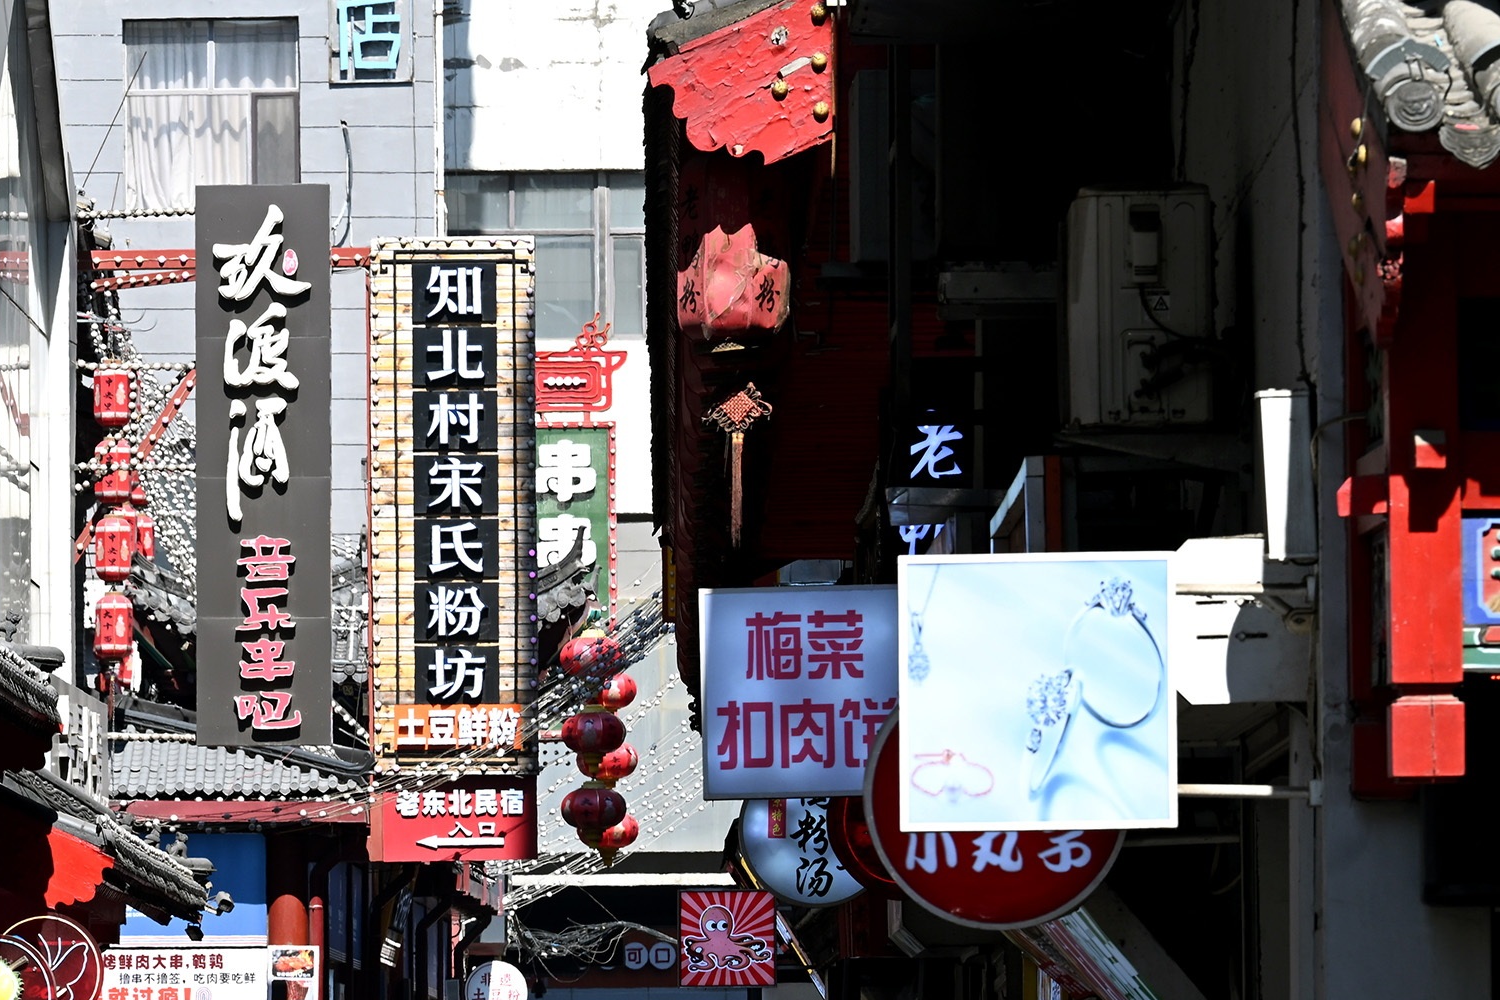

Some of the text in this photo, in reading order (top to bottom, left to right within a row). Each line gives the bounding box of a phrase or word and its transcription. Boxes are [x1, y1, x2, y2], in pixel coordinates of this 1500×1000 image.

[337, 0, 400, 70] 店
[426, 266, 486, 699] 知北村宋氏粉坊
[236, 535, 302, 732] 音乐串吧
[746, 609, 864, 681] 梅菜
[397, 707, 520, 746] 土豆鲜粉
[396, 788, 524, 817] 老东北民宿
[448, 820, 497, 837] 入口
[790, 797, 833, 897] 粉汤
[626, 947, 671, 964] 可口
